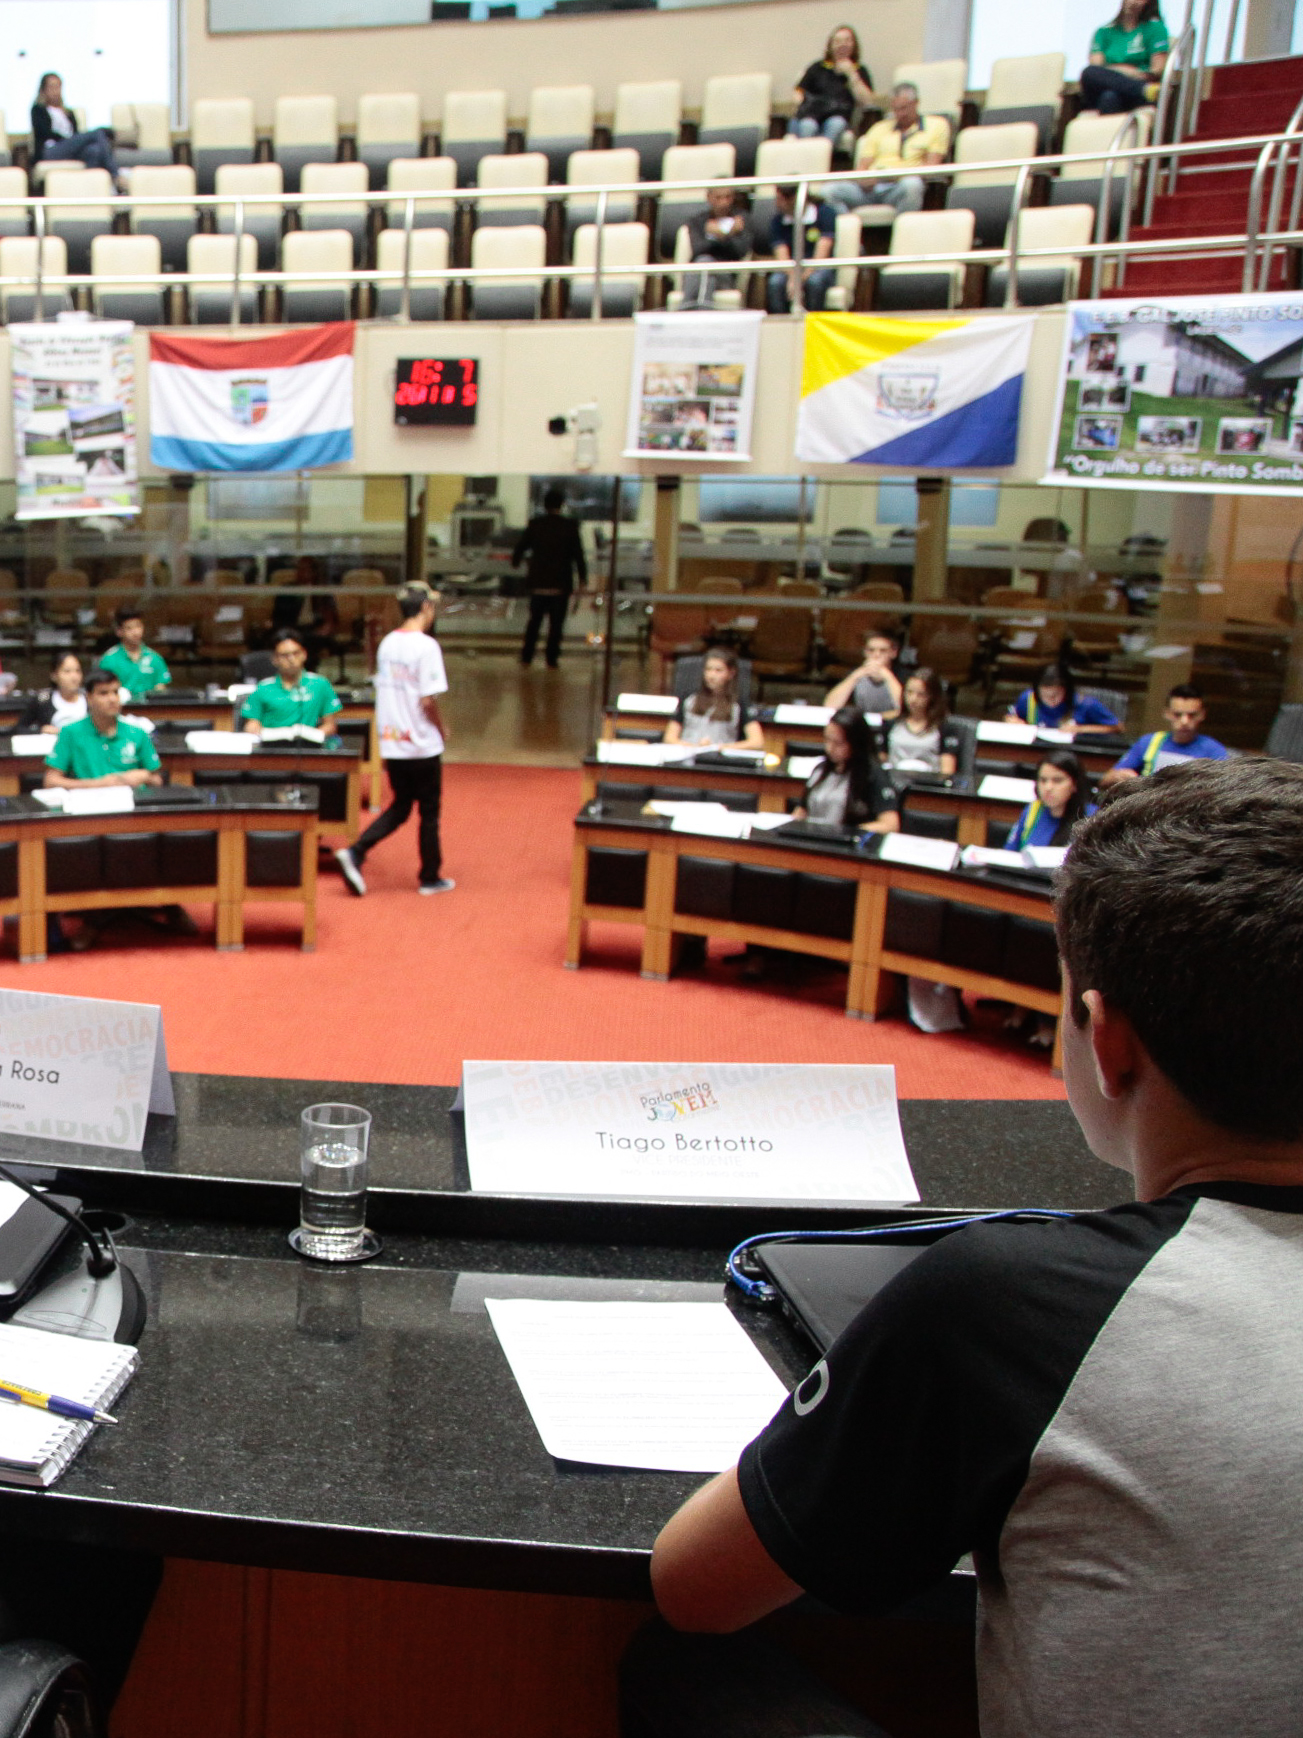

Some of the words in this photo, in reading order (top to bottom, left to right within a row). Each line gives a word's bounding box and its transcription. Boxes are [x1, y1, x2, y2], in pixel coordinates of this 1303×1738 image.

[1143, 459, 1166, 476] de
[1169, 462, 1196, 477] ser
[1200, 460, 1248, 479] Pinto
[12, 1060, 61, 1085] Rosa
[640, 1082, 711, 1108] Parlamento
[647, 1090, 719, 1121] JOVEM
[595, 1131, 666, 1153] Tiago
[675, 1133, 774, 1152] Bertotto
[668, 1154, 743, 1167] PRESIDENTE
